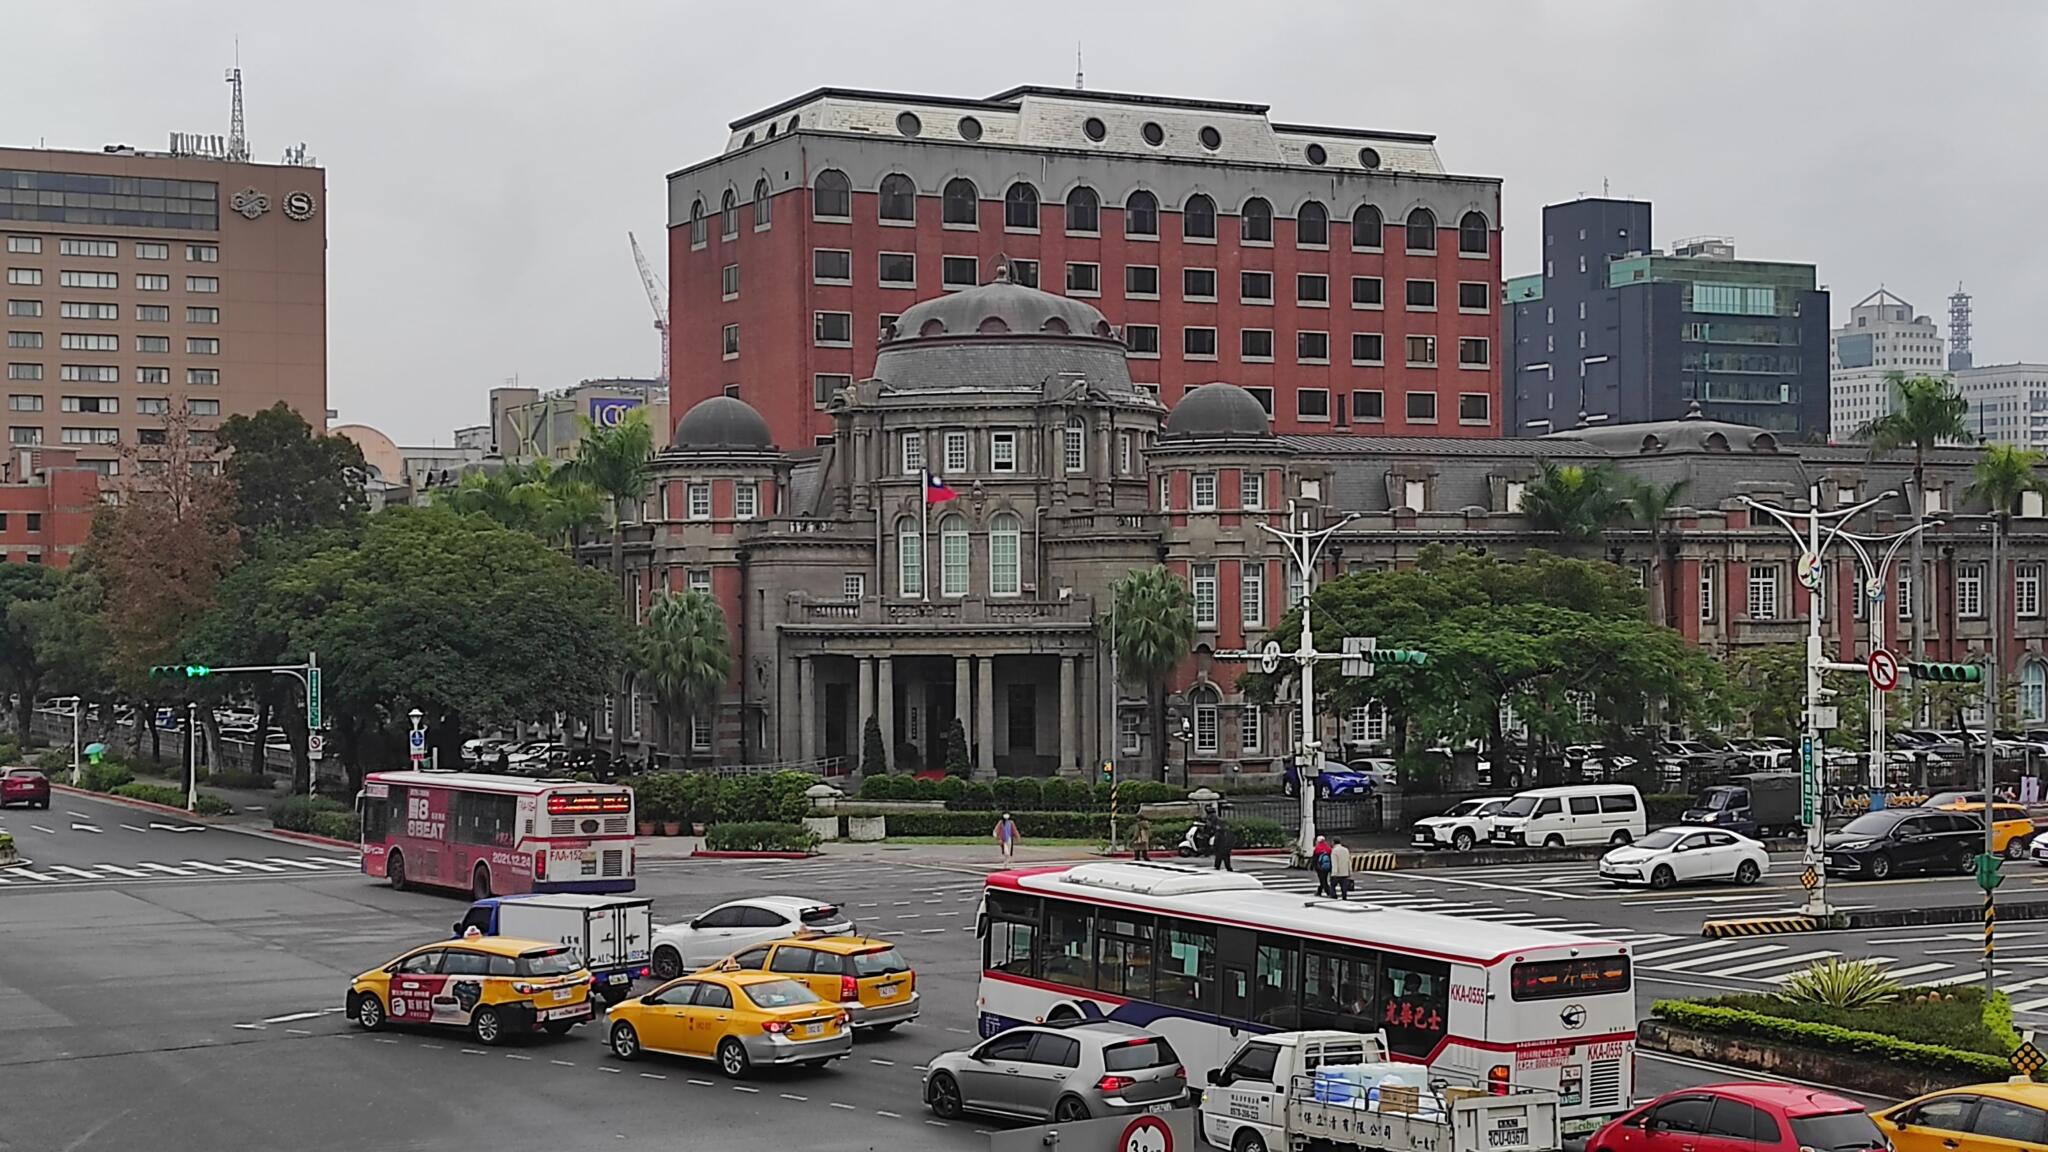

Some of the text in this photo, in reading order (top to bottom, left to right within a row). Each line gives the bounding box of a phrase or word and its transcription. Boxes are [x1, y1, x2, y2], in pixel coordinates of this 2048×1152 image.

[291, 195, 309, 214] S
[407, 821, 445, 839] 8BEAT
[1450, 984, 1485, 1005] KKA-0555
[1385, 1000, 1441, 1030] 光華巴士
[1587, 1040, 1622, 1061] KKA-0555
[1488, 1130, 1525, 1147] RCU-0367
